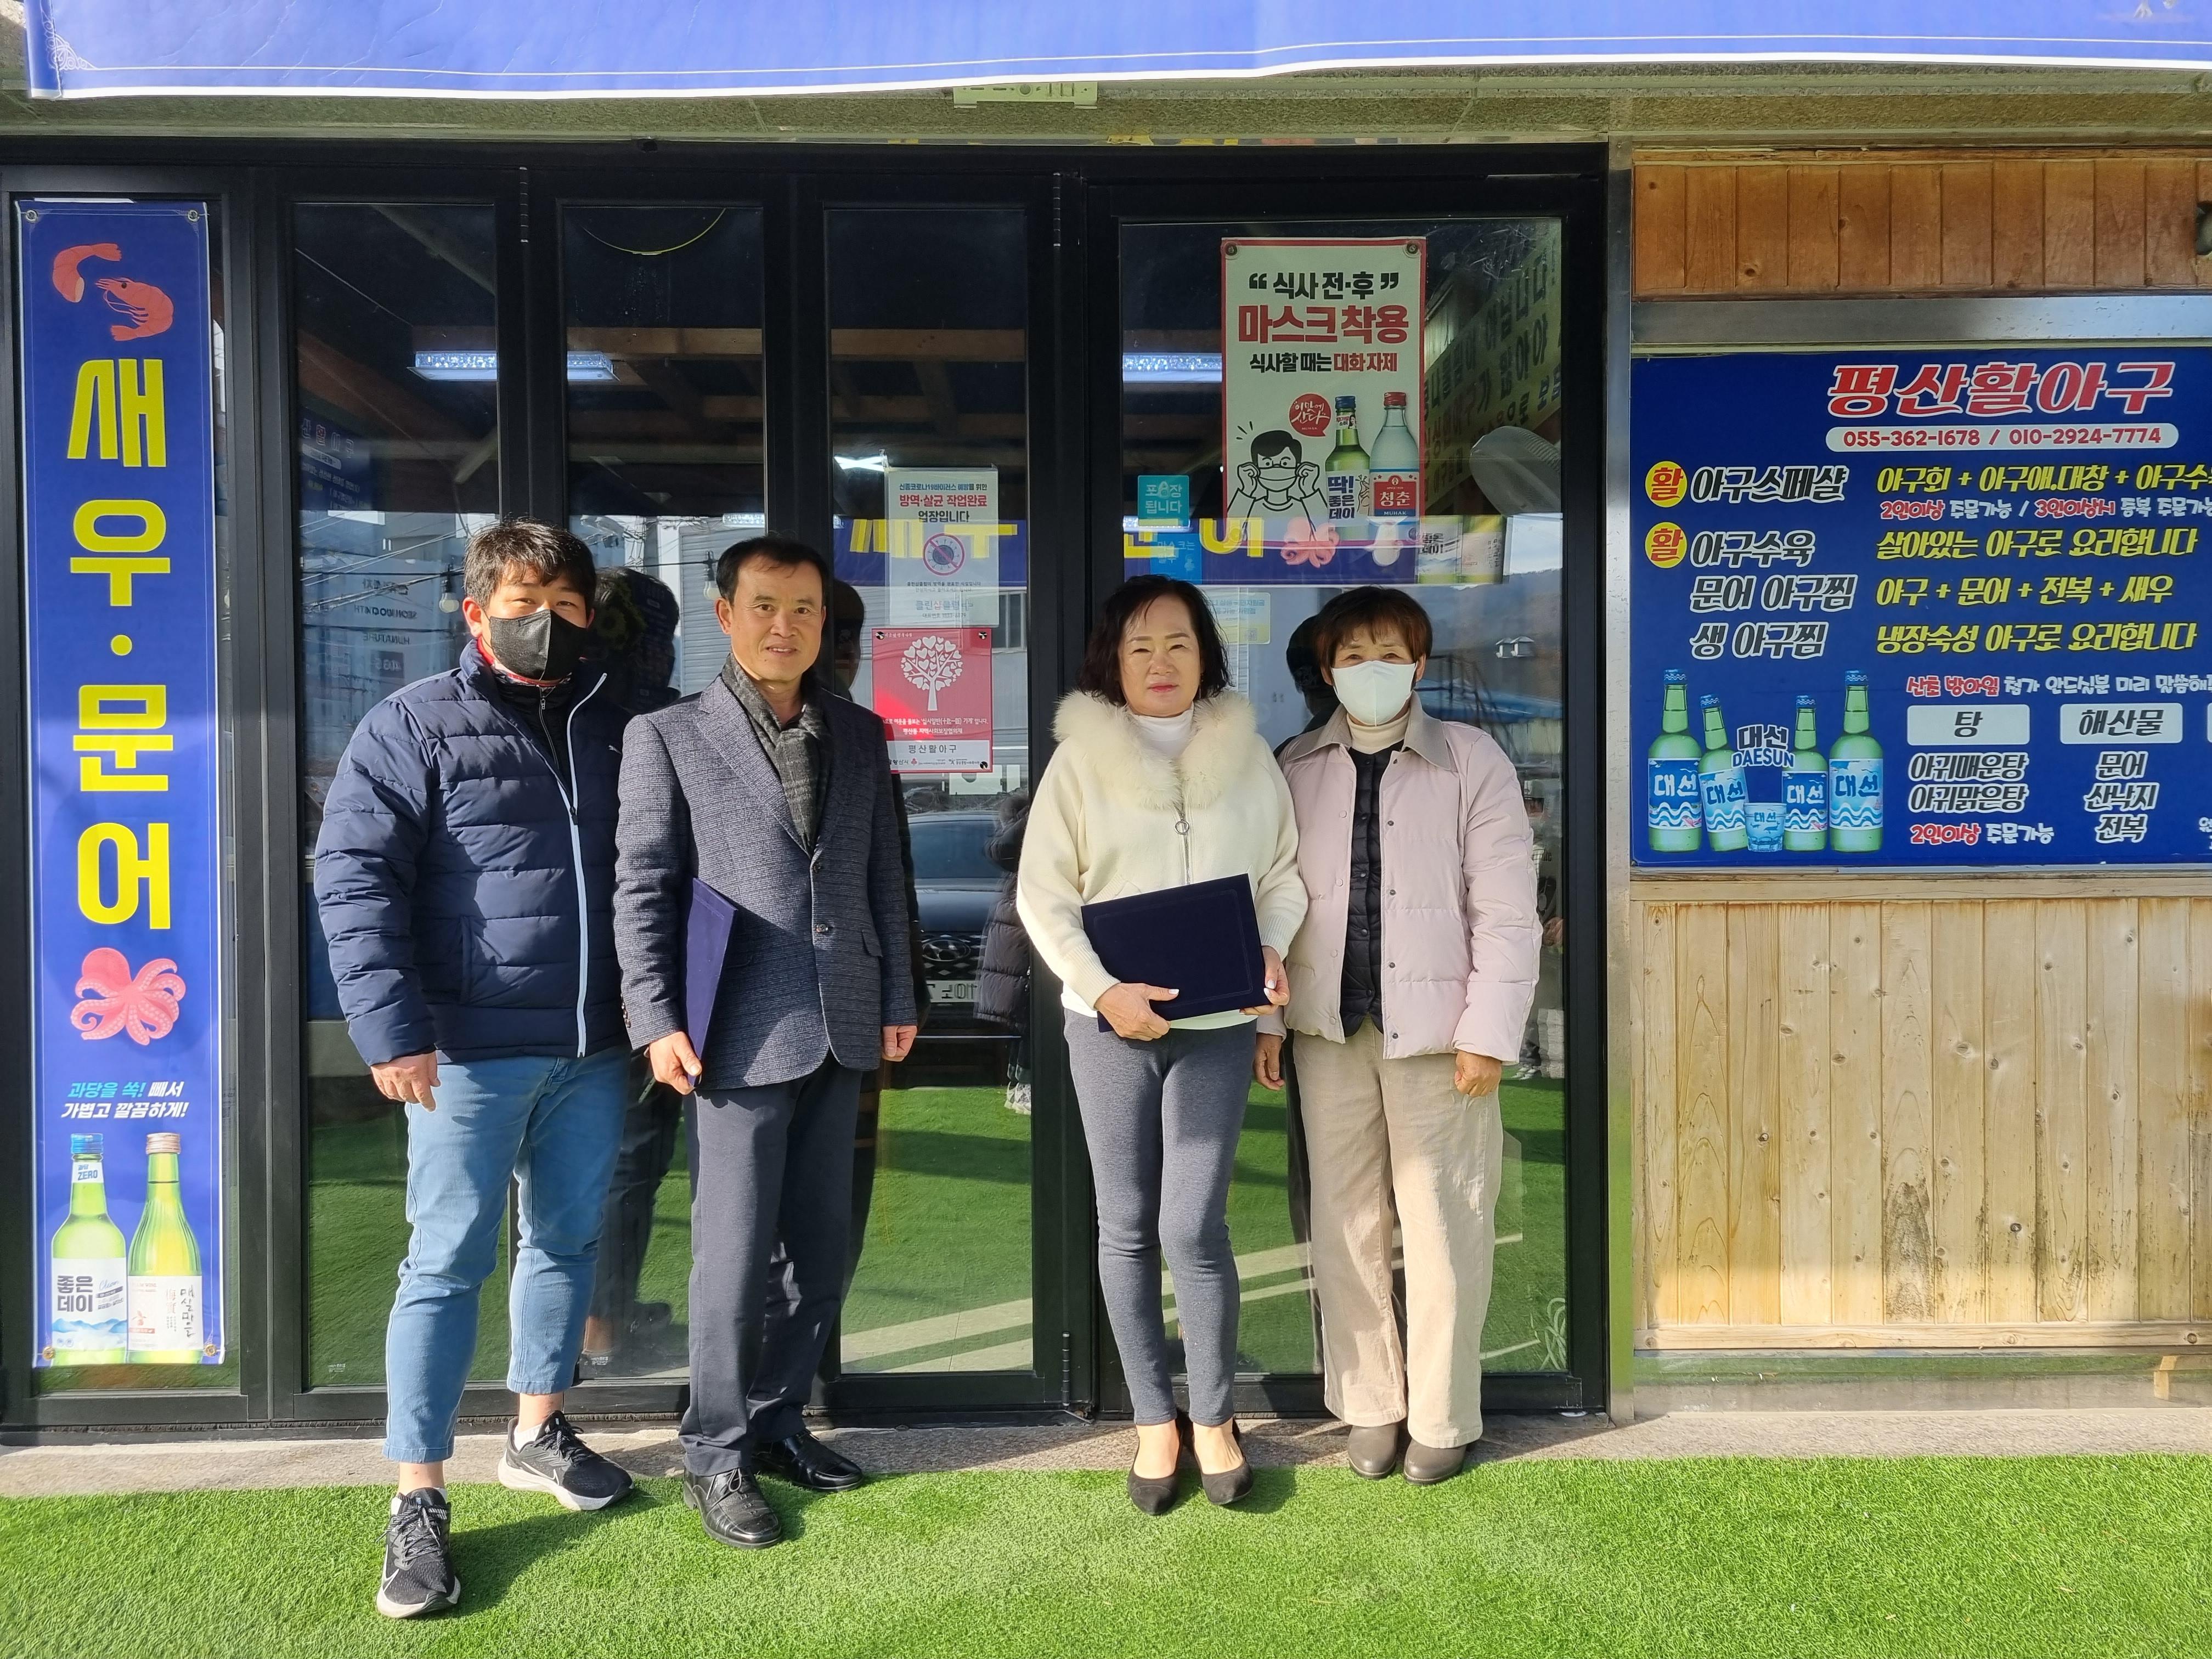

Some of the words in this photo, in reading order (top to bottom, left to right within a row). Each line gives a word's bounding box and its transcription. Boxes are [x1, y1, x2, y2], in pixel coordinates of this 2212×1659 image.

[1250, 353, 1298, 373] 식사할
[1301, 353, 1331, 372] 때는
[1829, 362, 2175, 417] 평산활아구
[1844, 430, 1980, 447] 055-362-1678
[2010, 428, 2161, 445] 010-2924-7774
[1328, 476, 1354, 494] 딱!
[1651, 467, 1683, 501] 활
[1691, 466, 1849, 503] 아구스페샬
[1877, 467, 1951, 493] 아구회
[2136, 465, 2212, 490] 아구수
[900, 495, 943, 507] 방역·살균
[946, 495, 988, 507] 작업완료
[1329, 495, 1354, 507] 좋은
[1380, 492, 1410, 506] 청춘
[1880, 499, 1945, 520] 2인이상
[1950, 499, 2012, 519] 주문가능
[2034, 498, 2116, 520] 3인이상시
[2120, 497, 2152, 517] 중복
[918, 511, 969, 523] 업장입니다
[1329, 507, 1355, 519] 데이
[1651, 528, 1683, 562] 활
[1691, 531, 1815, 568] 아구수육
[1877, 531, 1978, 559] 살아있는
[1987, 530, 2062, 557] 아구로
[2069, 528, 2198, 556] 요리합니다
[1690, 575, 1756, 613] 문어
[1762, 574, 1858, 611] 아구찜
[1877, 579, 1928, 606] 아구
[1958, 578, 2011, 605] 문어
[2039, 577, 2092, 605] 전복
[2118, 575, 2173, 603] 새우
[1690, 623, 1729, 660] 생
[1733, 622, 1829, 659] 아구찜
[1877, 625, 1979, 653] 냉장숙성
[1986, 624, 2062, 651] 아구로
[2068, 623, 2197, 651] 요리합니다
[1906, 675, 1941, 697] 산초
[1944, 675, 2000, 697] 방아잎
[2004, 676, 2040, 695] 첨가
[2045, 675, 2110, 694] 안드실분
[2115, 676, 2150, 692] 미리
[2155, 674, 2212, 694] 말씀해
[1954, 711, 1983, 737] 탕
[2079, 709, 2164, 736] 해산물
[1737, 724, 1789, 750] 대선
[909, 744, 957, 754] 평산활아구
[1731, 748, 1795, 768] DAESUN
[1909, 753, 2029, 781] 아귀매운탕
[2096, 751, 2148, 781] 문어
[1654, 774, 1699, 797] 대선
[1706, 781, 1746, 805] 대선
[1786, 783, 1825, 805] 대선
[1835, 774, 1880, 798] 대선
[2084, 783, 2159, 811] 산낙지
[1908, 783, 2029, 813] 아귀맑은탕
[1910, 823, 1981, 845] 2인이상
[1985, 823, 2055, 844] 주문가능
[2095, 814, 2148, 843] 전복
[67, 1082, 118, 1098] 과당을
[148, 1081, 184, 1097] 빼서
[61, 1103, 111, 1119] 가볍고
[114, 1102, 189, 1119] 깔끔하게!
[78, 1170, 98, 1181] ZERO
[57, 1276, 93, 1294] 좋은
[57, 1294, 93, 1312] 데이
